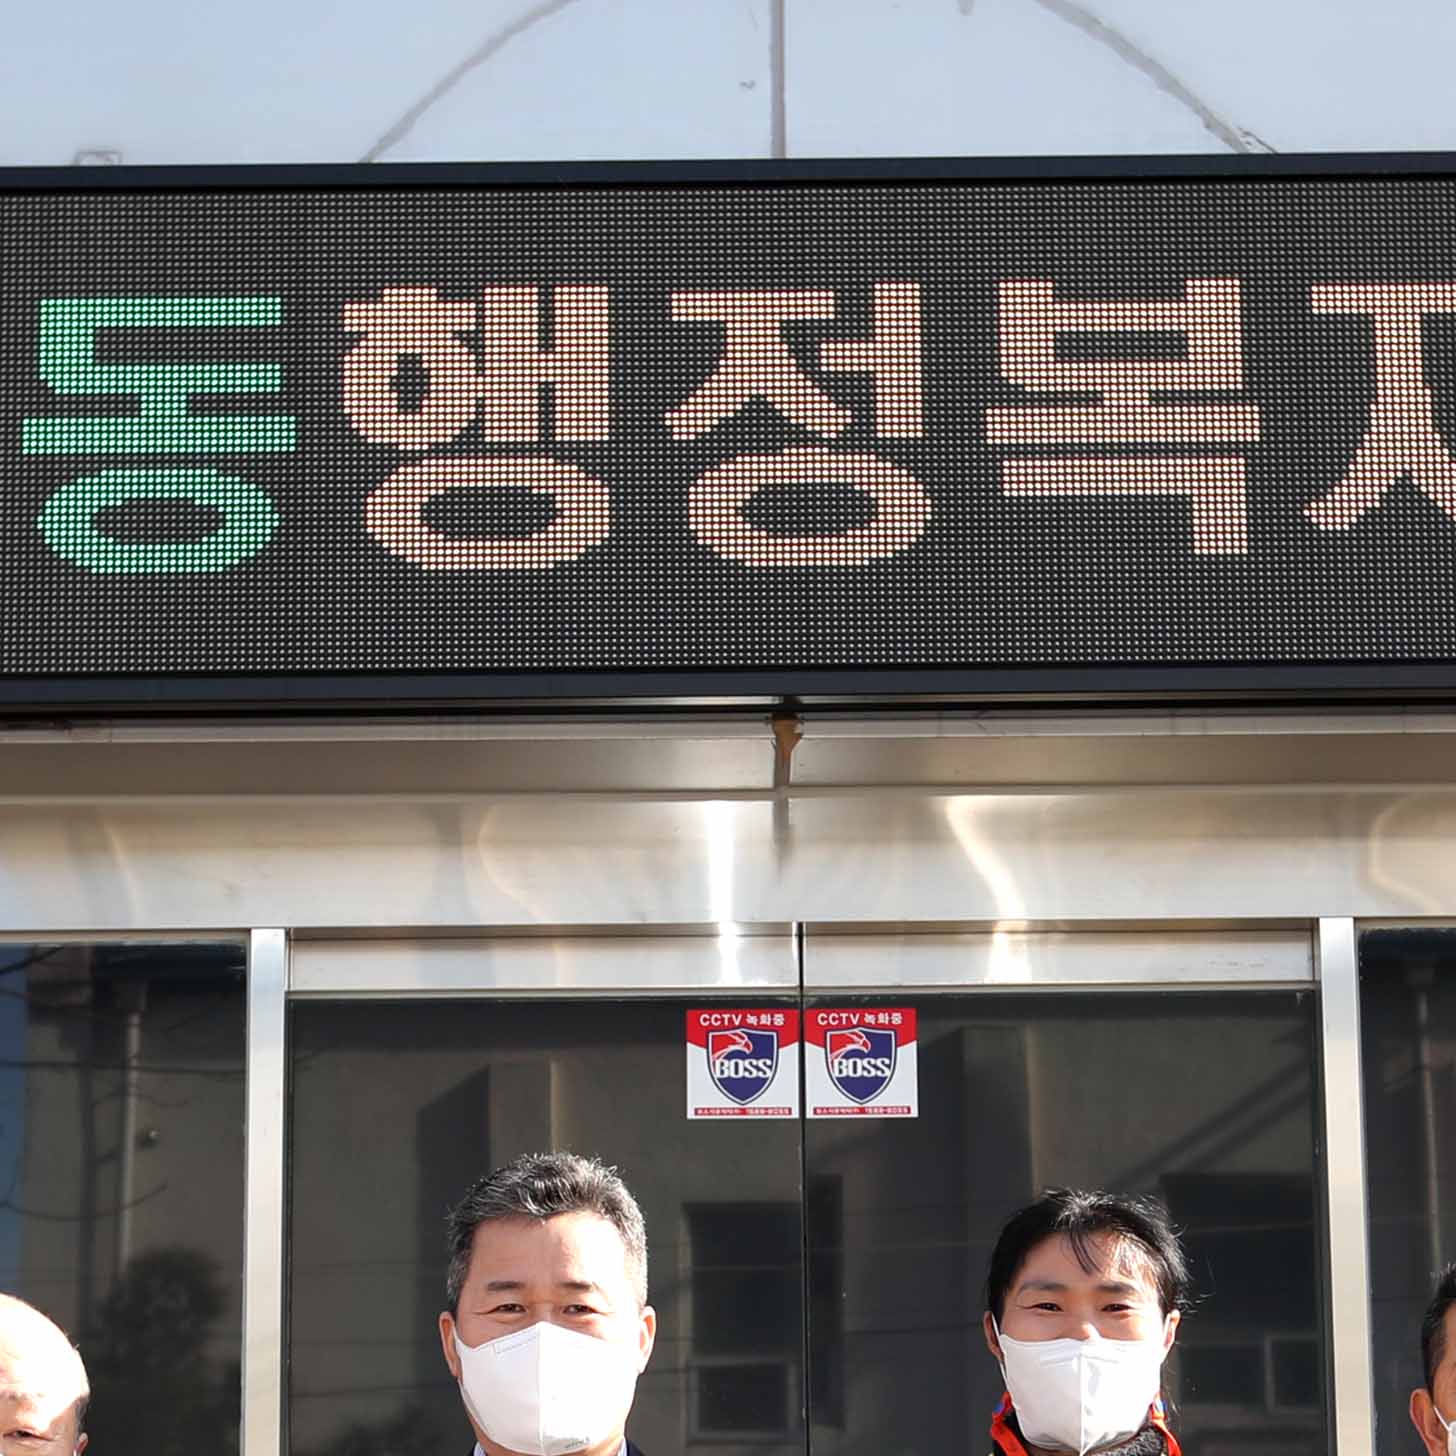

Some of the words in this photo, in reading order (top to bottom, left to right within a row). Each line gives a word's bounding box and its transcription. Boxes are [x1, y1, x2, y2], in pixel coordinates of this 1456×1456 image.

[699, 1013, 742, 1026] CCTV
[746, 1013, 785, 1026] 녹화중
[817, 1012, 860, 1025] CCTV
[864, 1012, 903, 1025] 녹화중
[715, 1058, 772, 1078] BOSS
[833, 1058, 891, 1077] BOSS
